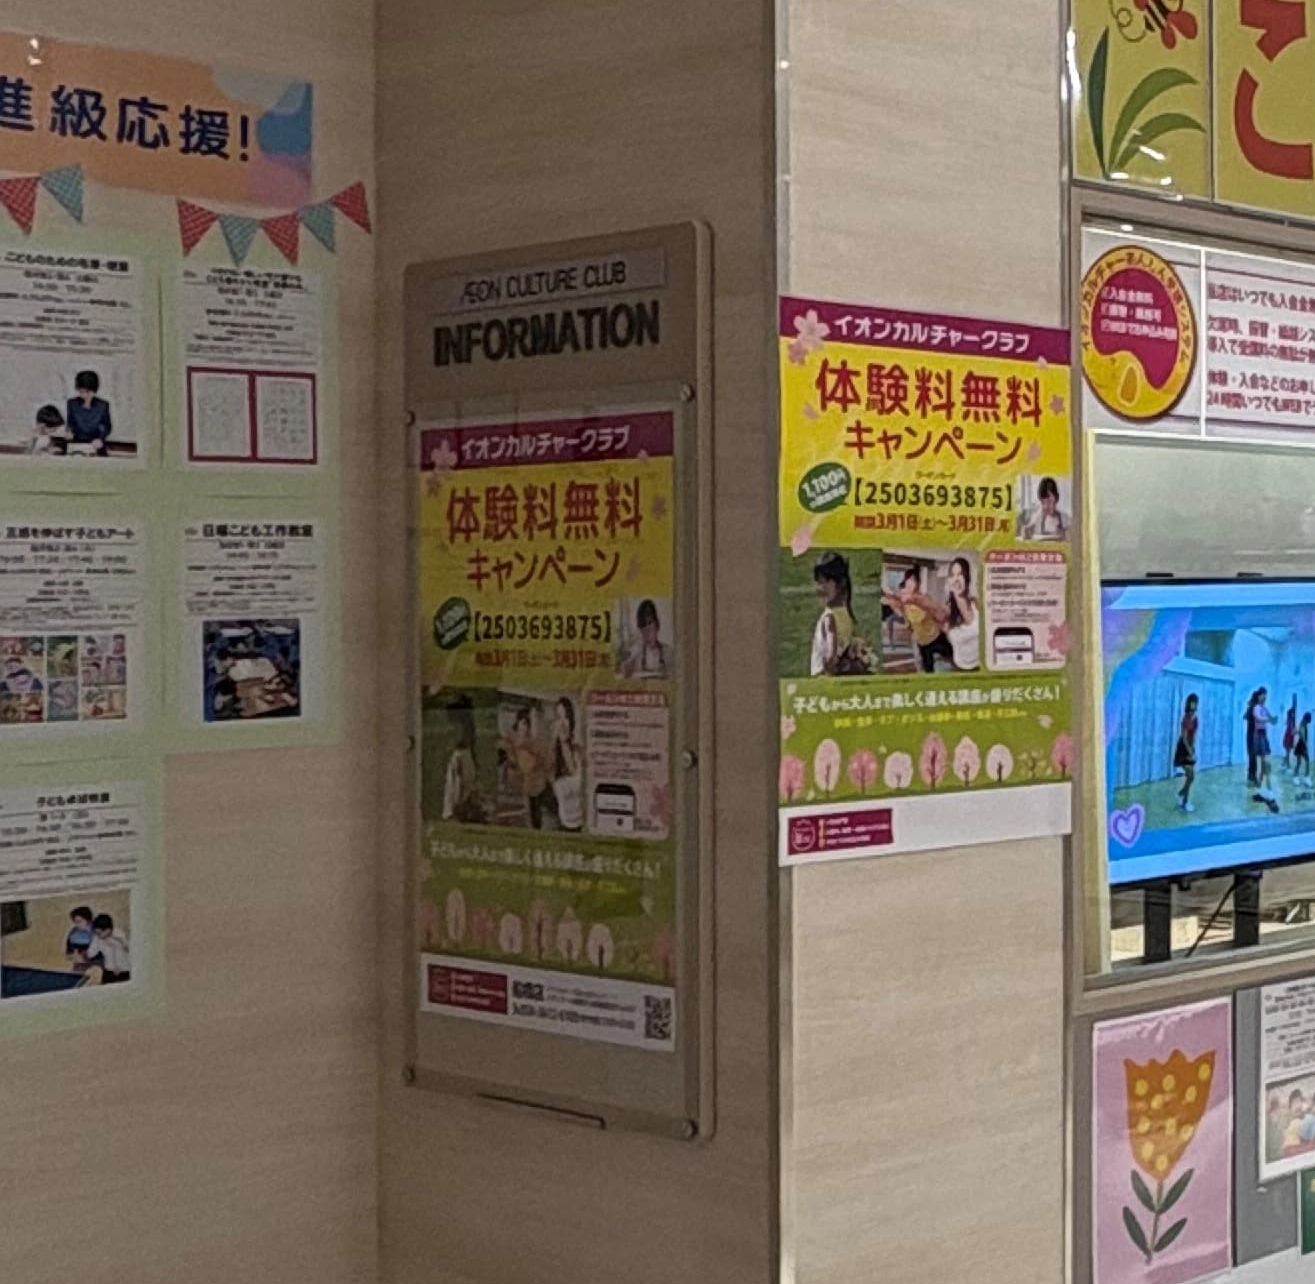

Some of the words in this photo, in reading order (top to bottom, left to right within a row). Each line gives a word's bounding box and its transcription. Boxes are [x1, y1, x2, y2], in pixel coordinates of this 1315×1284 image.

[507, 267, 577, 298] CULTURE
[584, 261, 626, 287] CLUB
[434, 300, 660, 367] INFORMATION
[833, 315, 1030, 353] イオンカルチャークラブ
[816, 359, 1041, 426] 体験料無料
[461, 425, 629, 459] イオンカルチャークラブ
[845, 420, 1022, 464] キャンペーン
[447, 479, 643, 544] 体験料無料
[466, 546, 620, 592] キャンペーン
